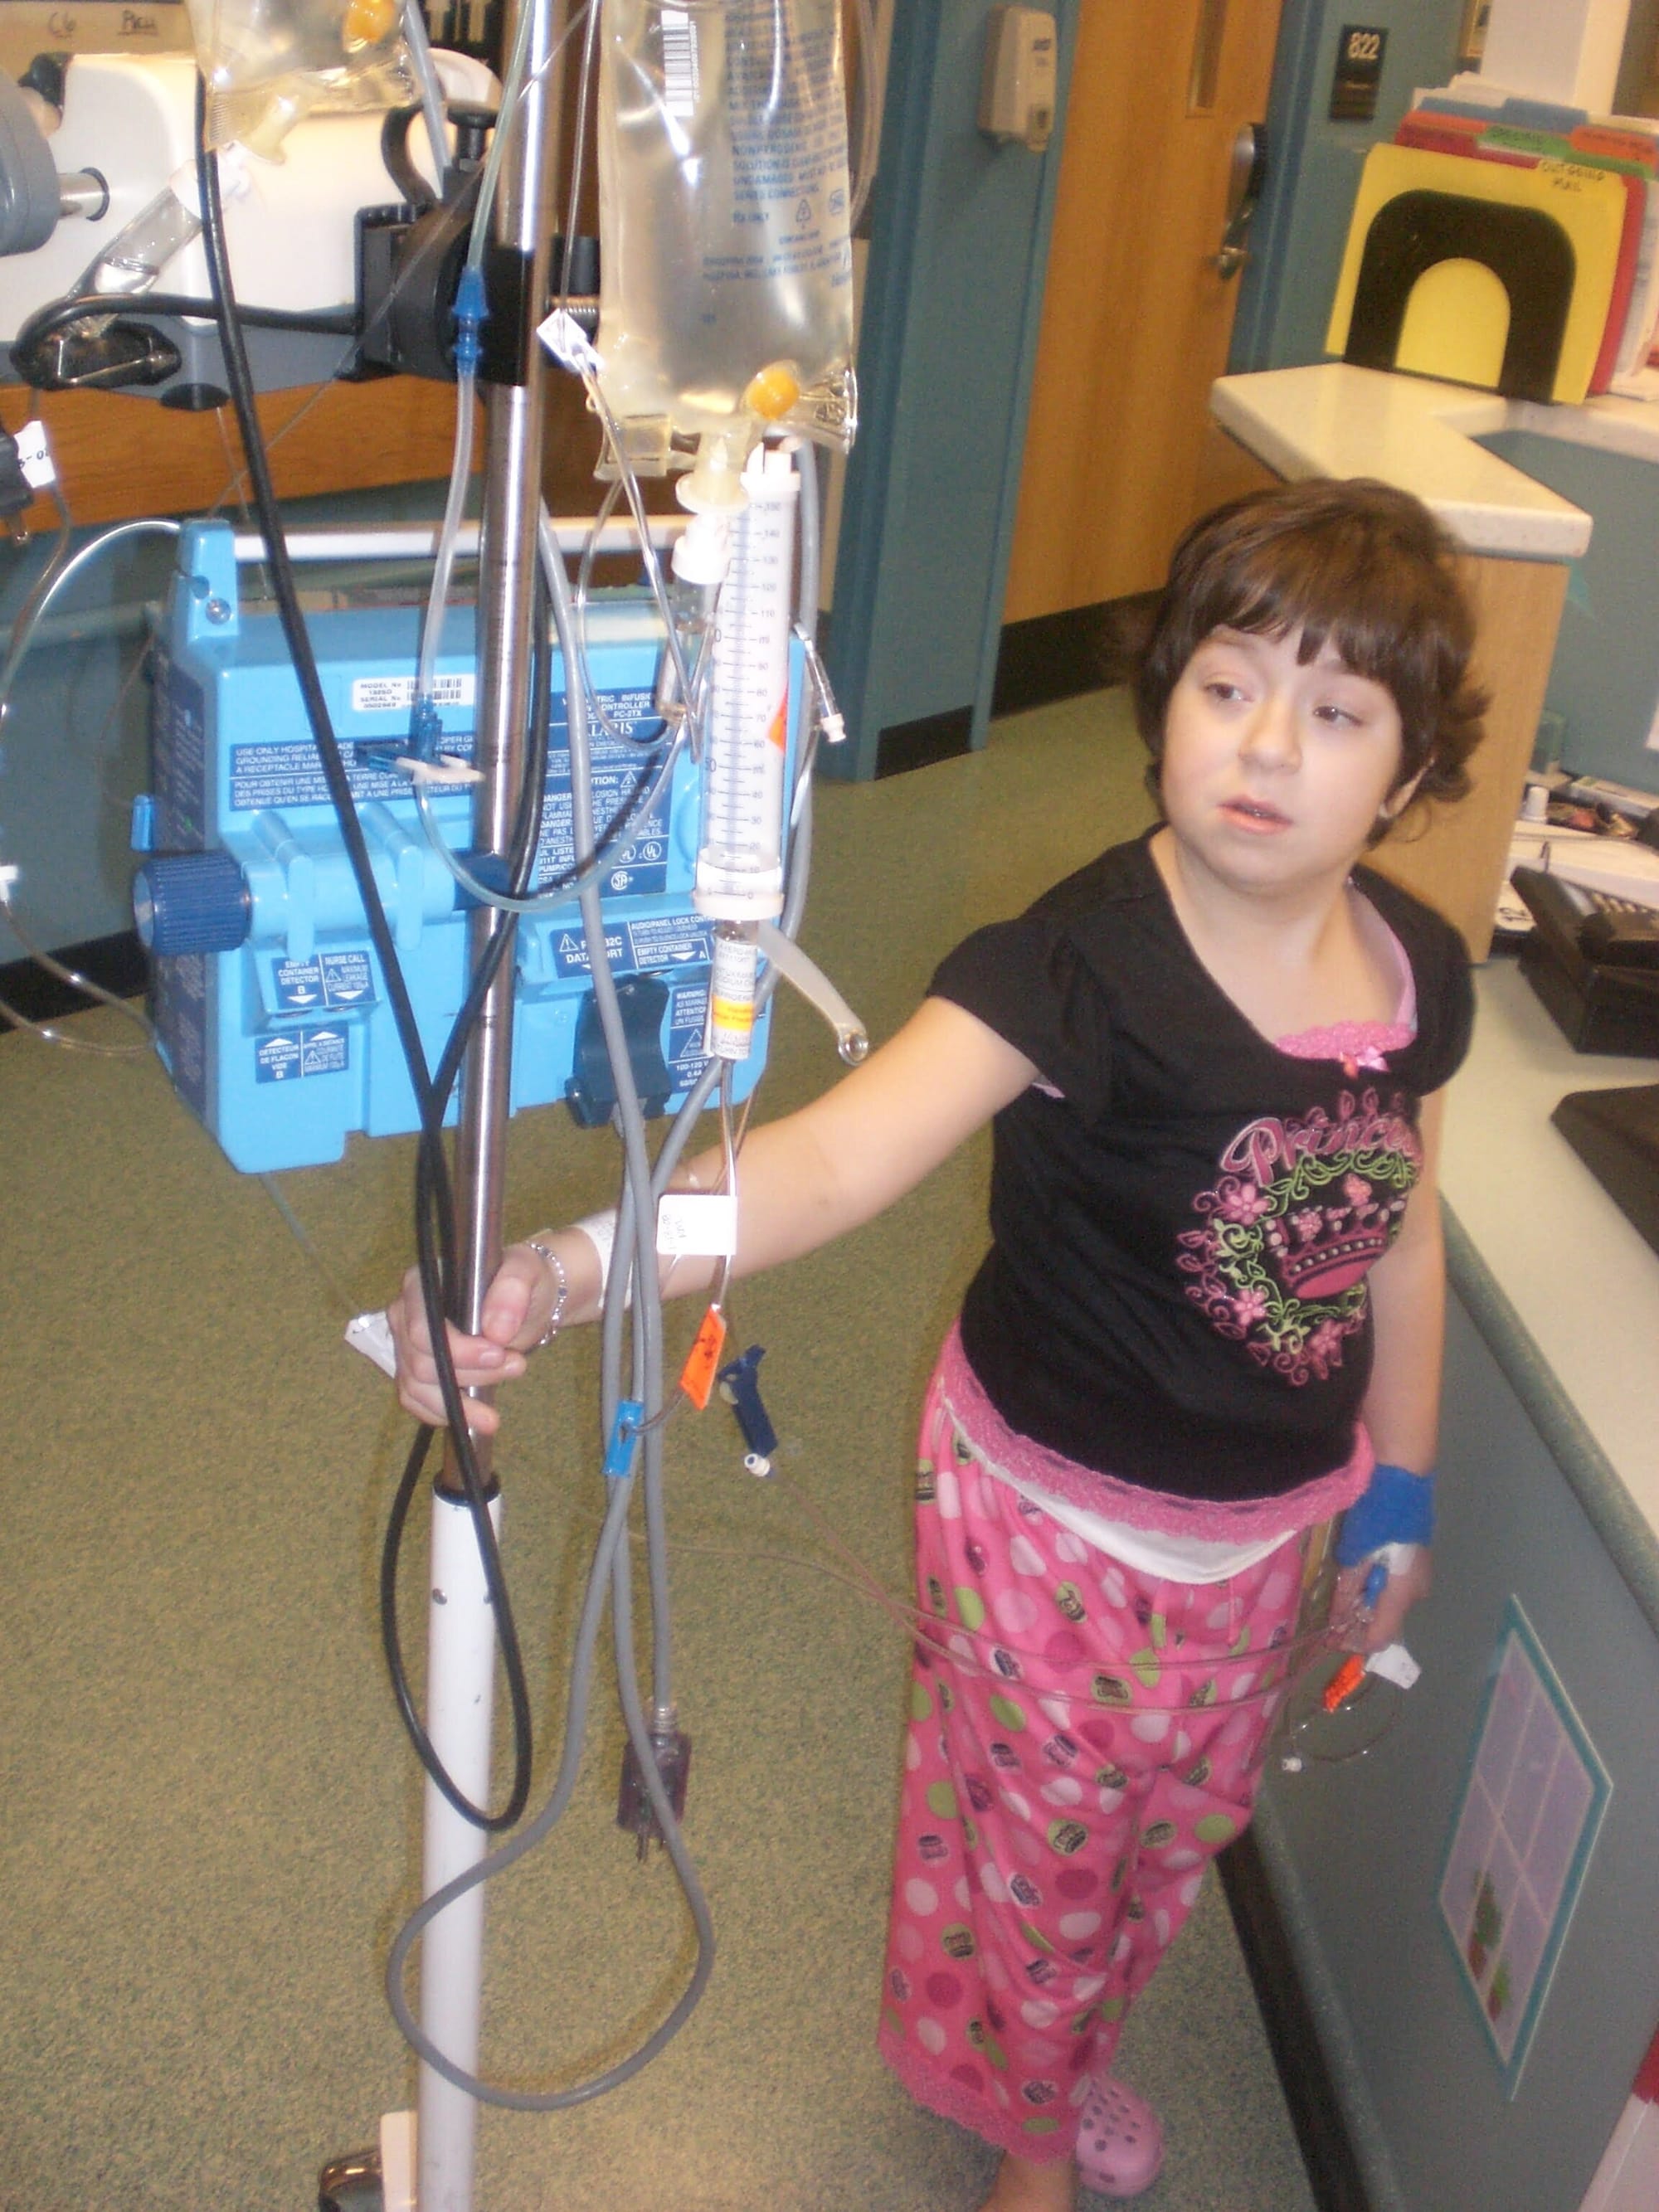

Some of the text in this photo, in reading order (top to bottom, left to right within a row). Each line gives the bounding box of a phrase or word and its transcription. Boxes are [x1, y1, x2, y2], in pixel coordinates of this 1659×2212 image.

[1348, 32, 1380, 60] 822
[764, 530, 780, 539] 140
[763, 557, 778, 566] 130
[762, 583, 776, 591] 120
[761, 610, 775, 619] 110
[756, 688, 767, 697] 80
[756, 714, 766, 722] 70
[236, 748, 254, 756] USE
[255, 746, 279, 756] ONLY
[281, 743, 317, 753] HOSPITA
[236, 755, 289, 765] GROUNDING
[242, 762, 300, 772] RECEPTACLE
[234, 780, 257, 789] POUR
[258, 777, 293, 787] OBTENIR
[295, 776, 311, 785] UNE
[352, 773, 377, 781] TERRE
[234, 790, 251, 798] DES
[252, 787, 281, 796] PRISES
[282, 786, 294, 795] DU
[353, 782, 369, 790] UNE
[370, 780, 389, 790] MISE
[234, 795, 273, 805] OBTENUE
[373, 789, 390, 797] UNE
[391, 787, 413, 796] PRISE
[752, 791, 763, 800] 40
[751, 816, 762, 824] 30
[749, 841, 761, 850] 20
[552, 846, 573, 856] LISTE
[747, 892, 754, 900] 0
[672, 916, 690, 926] LOCK
[636, 942, 693, 956] EMPTY CONTAINER
[324, 954, 366, 965] NURSE CALL
[638, 955, 669, 965] DETECTOR
[699, 950, 706, 960] A
[278, 966, 319, 977] CONTAINER
[280, 975, 319, 985] DETECTOR
[297, 984, 306, 994] B
[674, 1006, 707, 1017] ATTENTIO
[259, 1043, 299, 1056] DETECTEUR
[260, 1053, 299, 1064] DE FLACON
[275, 1070, 285, 1079] B
